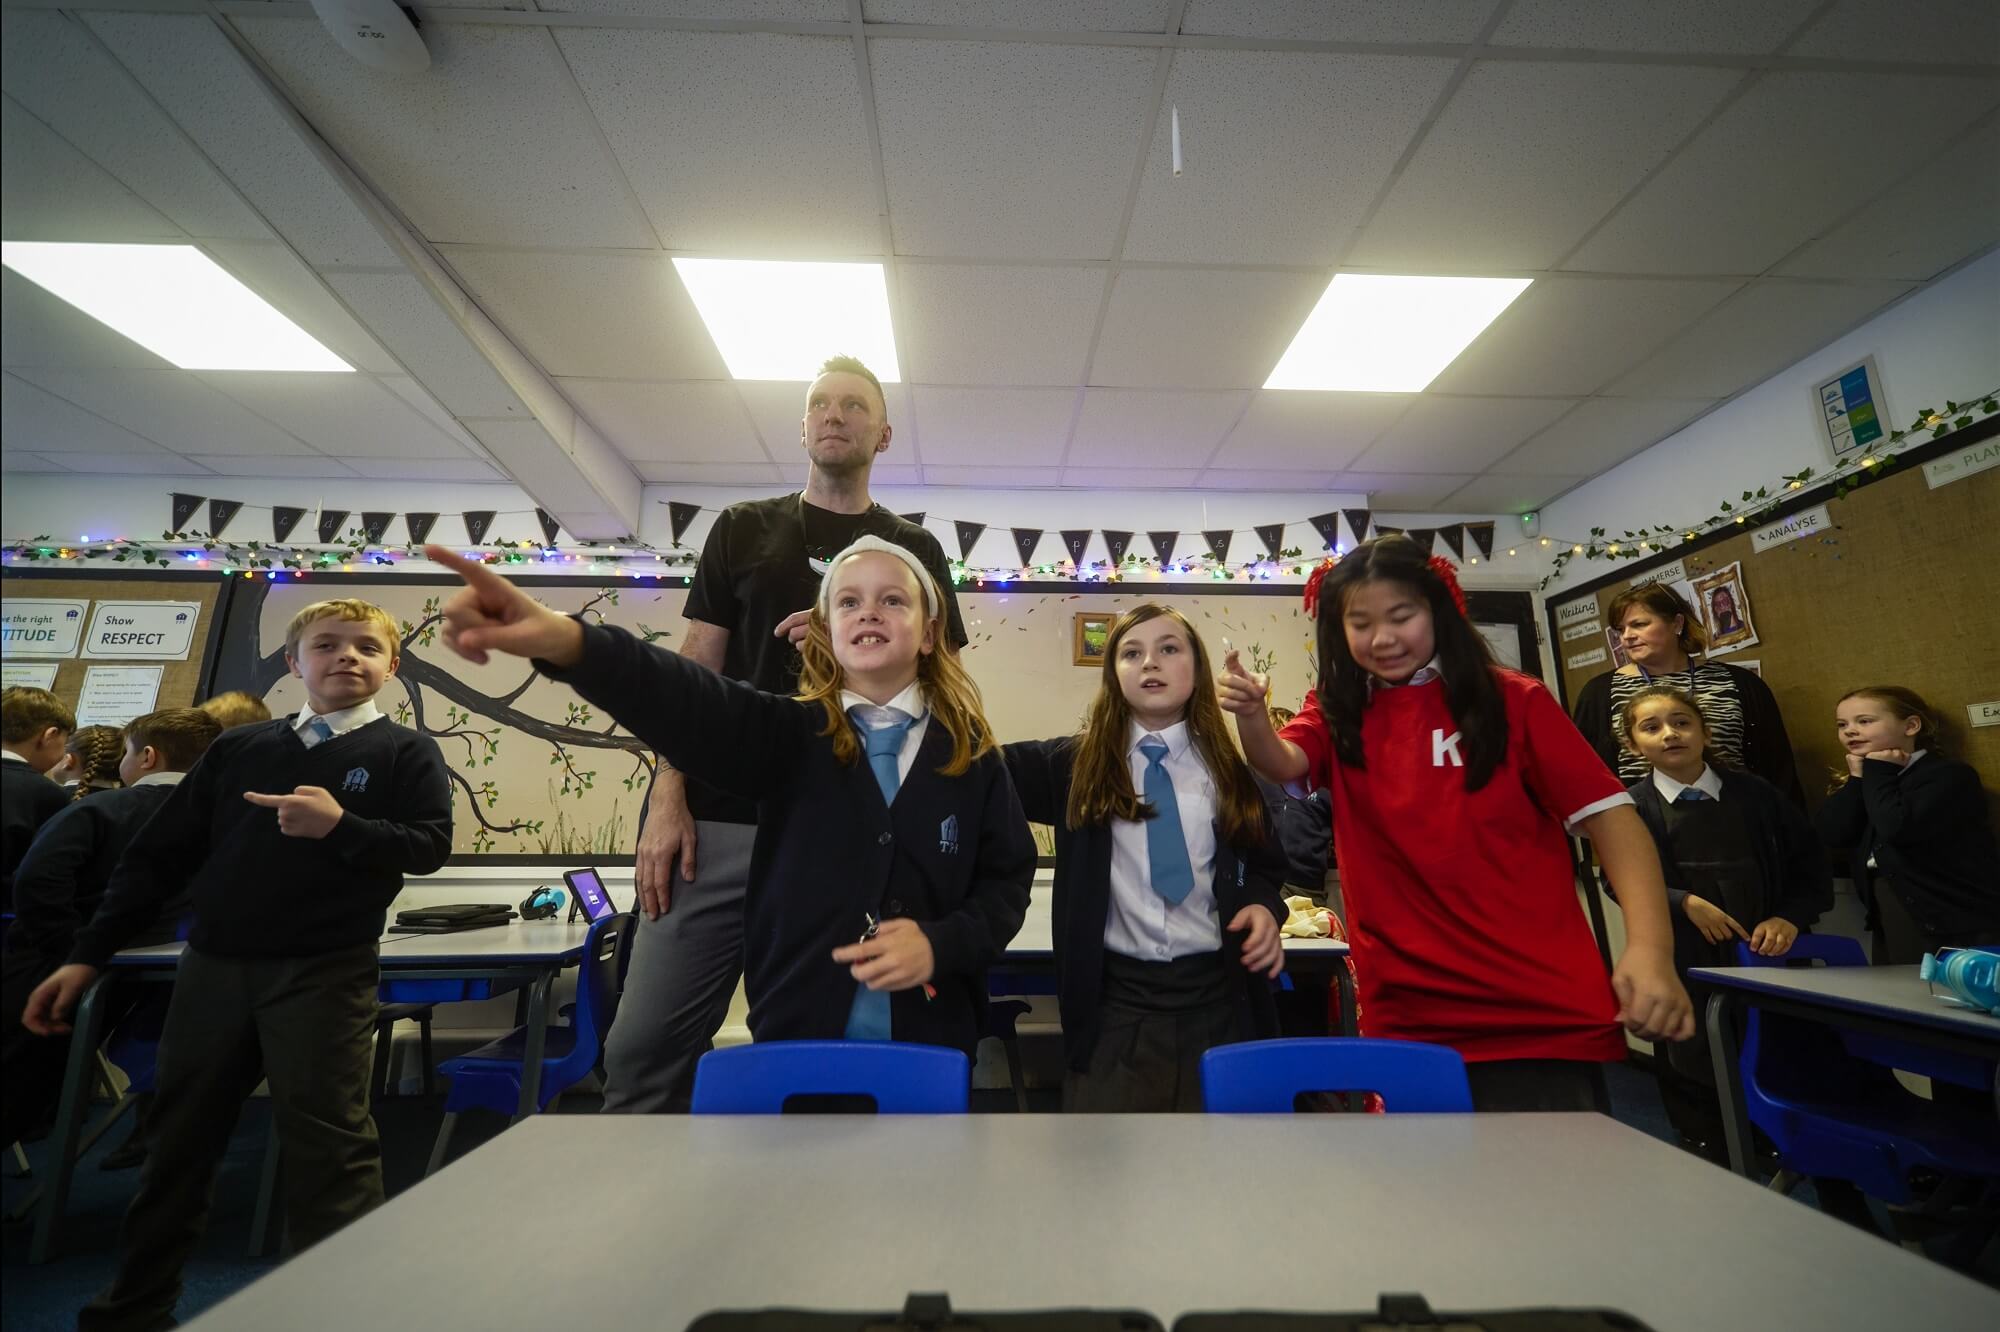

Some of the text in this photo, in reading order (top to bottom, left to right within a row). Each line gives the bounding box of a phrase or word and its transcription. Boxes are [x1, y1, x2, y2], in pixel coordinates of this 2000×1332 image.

[176, 504, 188, 513] a
[217, 504, 226, 518] b
[323, 513, 334, 528] d
[472, 520, 482, 535] g
[1768, 515, 1818, 541] ANALYSE
[1071, 540, 1081, 553] p
[1215, 539, 1225, 548] s
[1559, 602, 1596, 620] Writing
[13, 614, 27, 623] the
[30, 615, 53, 626] right
[104, 615, 135, 625] Show
[100, 632, 166, 645] RESPECT
[1432, 728, 1464, 766] K
